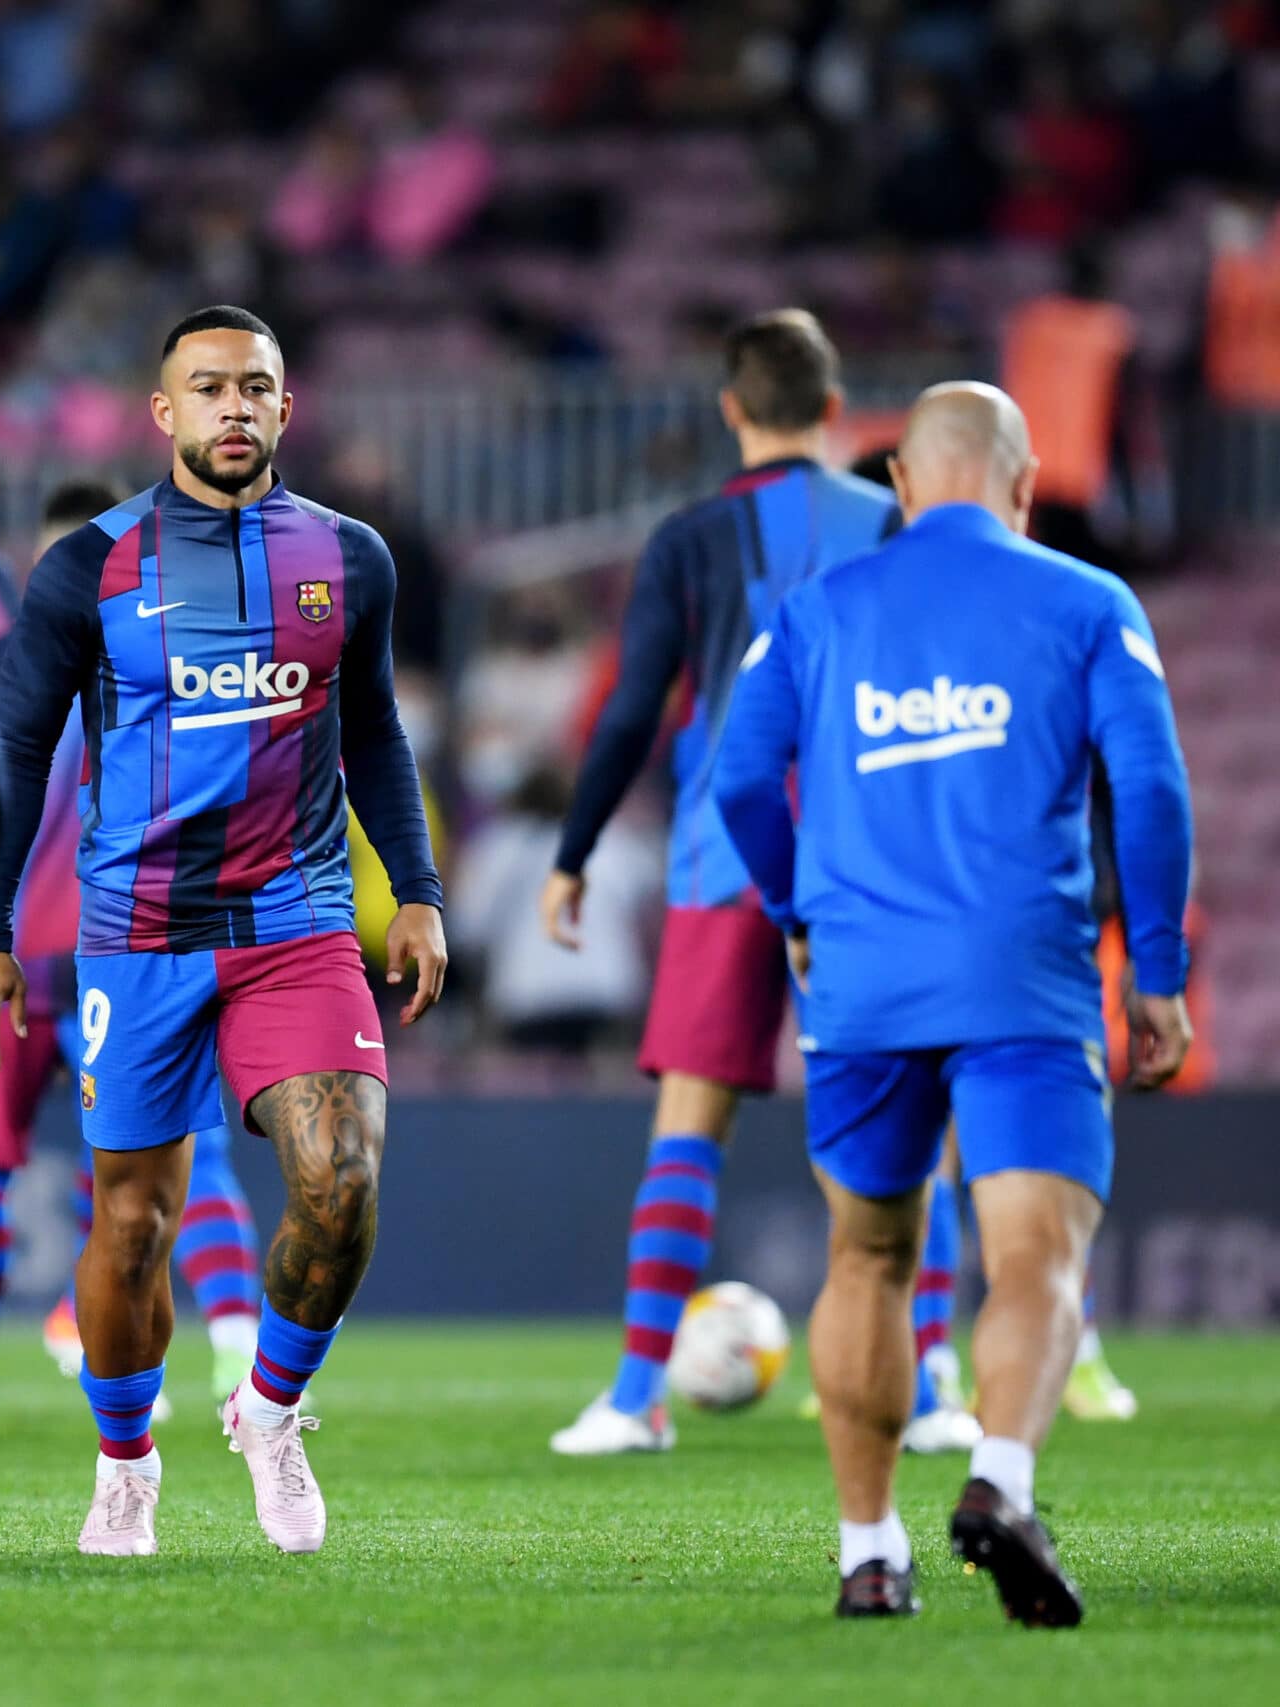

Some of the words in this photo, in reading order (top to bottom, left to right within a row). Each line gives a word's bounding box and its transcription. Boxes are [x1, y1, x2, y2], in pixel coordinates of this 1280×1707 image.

[170, 652, 309, 699] beko
[854, 675, 1013, 737] beko
[82, 987, 111, 1066] 9
